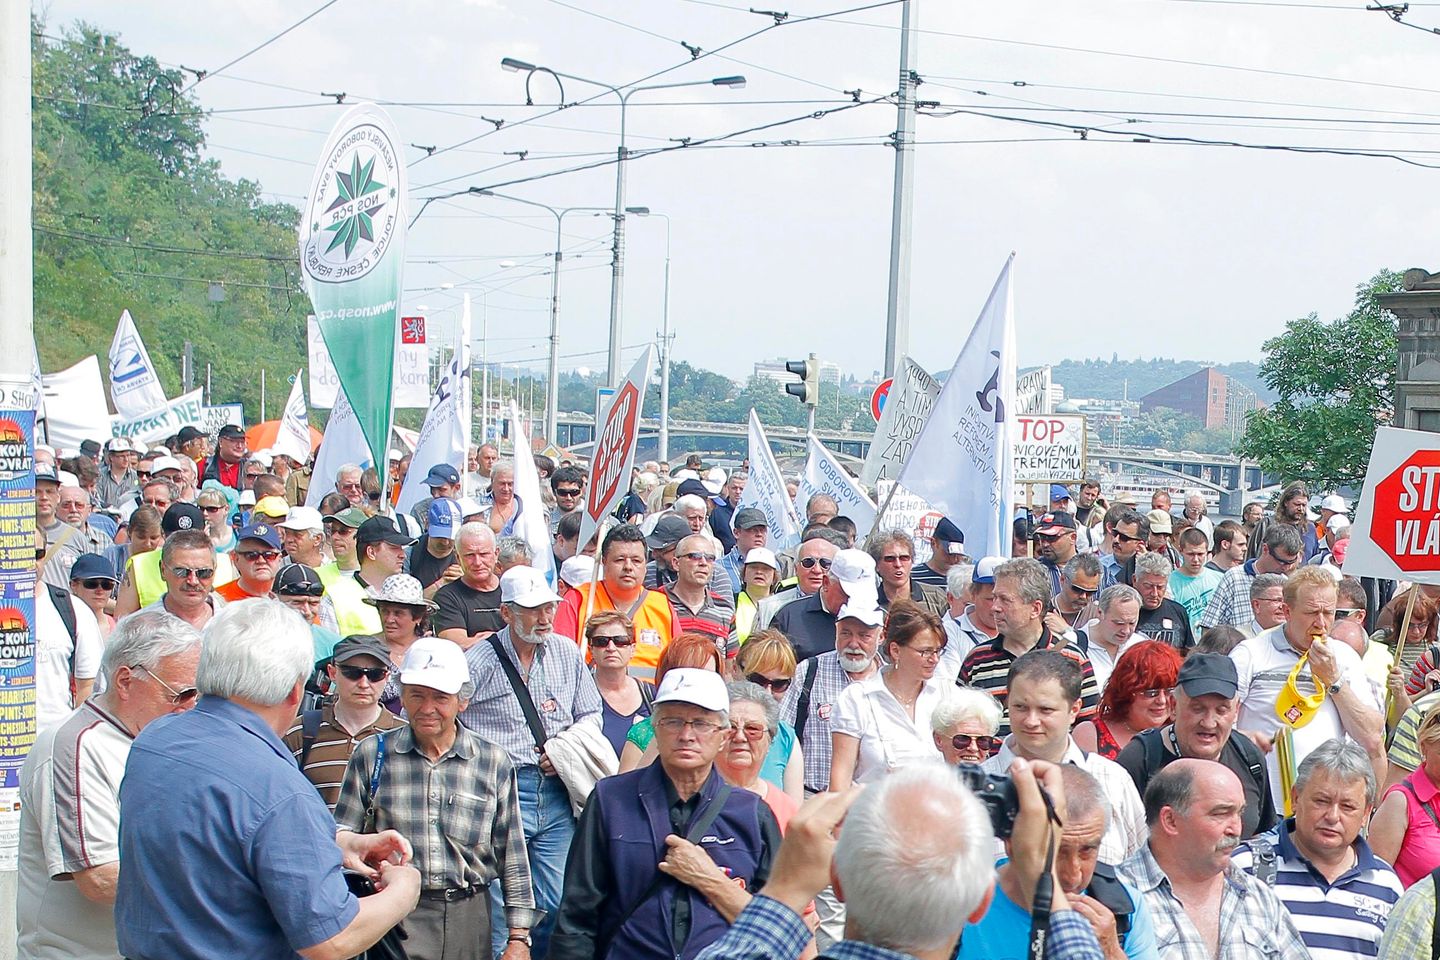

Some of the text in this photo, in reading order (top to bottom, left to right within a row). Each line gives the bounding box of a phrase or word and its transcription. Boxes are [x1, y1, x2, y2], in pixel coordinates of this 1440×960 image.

[11, 389, 33, 410] SHO
[207, 407, 231, 419] ANO
[598, 391, 632, 471] STOP
[1017, 418, 1065, 445] TOP
[0, 442, 28, 458] KOVÝ
[0, 456, 33, 471] OVRAT
[594, 433, 627, 513] VLÁDĚ
[1014, 457, 1081, 470] TREMIZMU
[750, 466, 765, 499] TNÍCH
[819, 459, 862, 508] ODBOROVÝ
[821, 481, 843, 504] SVAZ
[0, 645, 35, 660] OVRAT
